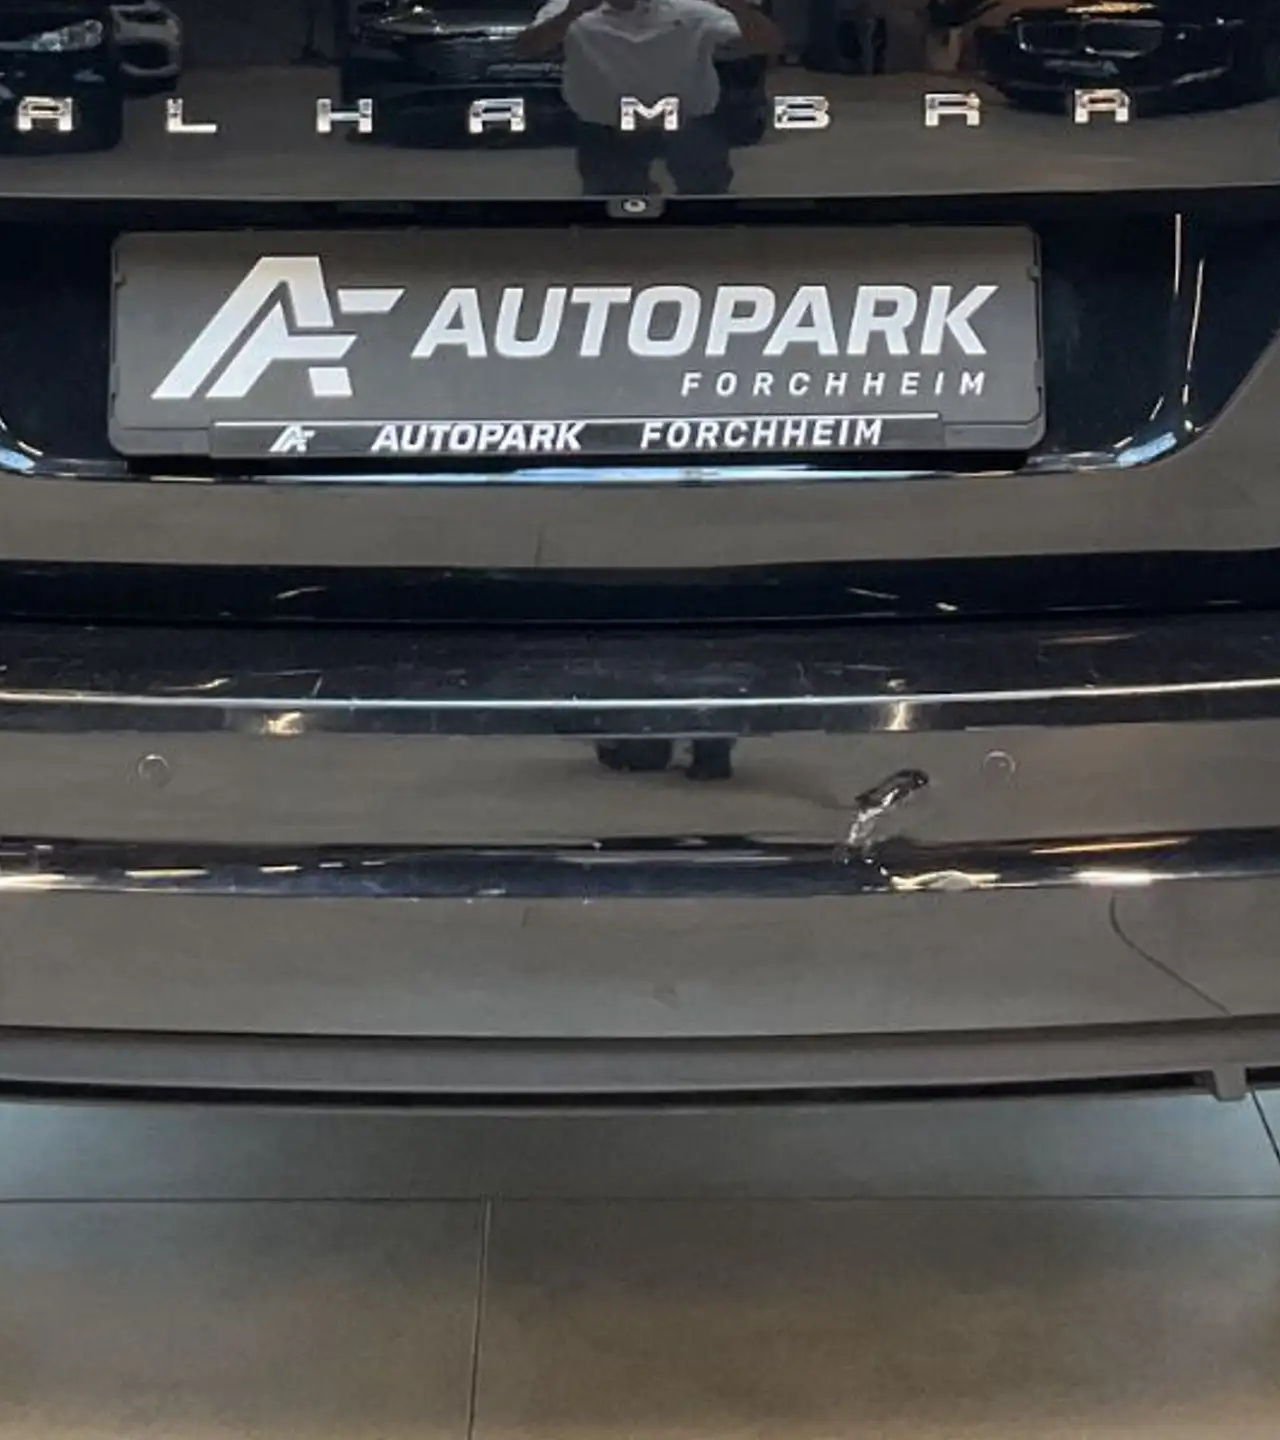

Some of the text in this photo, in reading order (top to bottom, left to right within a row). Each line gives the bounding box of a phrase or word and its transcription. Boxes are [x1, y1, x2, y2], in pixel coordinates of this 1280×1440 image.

[17, 88, 1131, 133] ALHAMBRA
[410, 285, 999, 357] AUTOPARK
[680, 371, 986, 397] FORCHHEIM
[371, 423, 586, 453] AUTOPARK
[640, 419, 883, 450] FORCHHEIM
